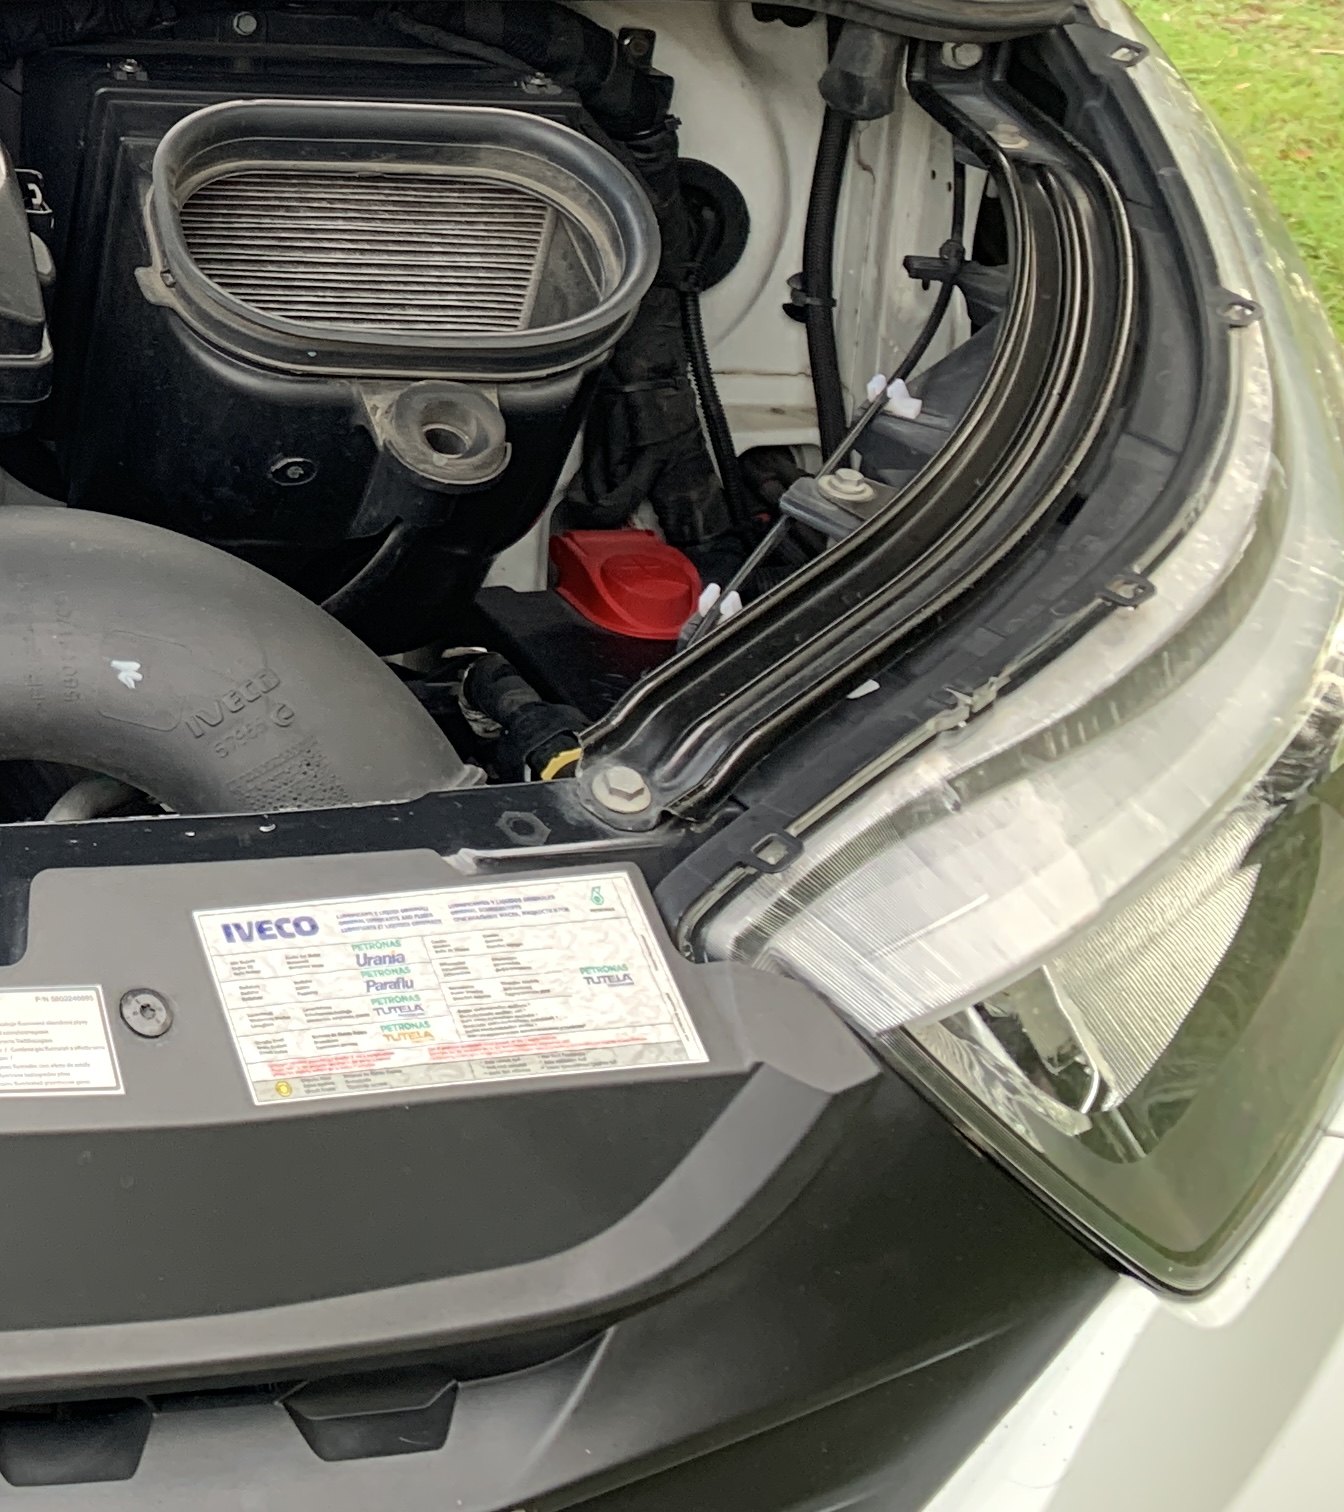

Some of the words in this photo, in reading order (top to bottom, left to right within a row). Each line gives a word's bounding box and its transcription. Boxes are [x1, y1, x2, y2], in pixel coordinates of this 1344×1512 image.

[185, 668, 281, 739] IVECO
[220, 915, 320, 944] IVECO
[351, 940, 402, 951] PETRONAS
[355, 950, 406, 967] Urania
[360, 966, 411, 978] PETRONAS
[579, 964, 629, 975] PETRONAS
[366, 977, 414, 993] Paraflu
[583, 974, 633, 986] TUTELA
[370, 994, 421, 1005] PETRONAS
[373, 1004, 424, 1016] TUTELA
[380, 1021, 431, 1033] PETRONAS
[383, 1031, 434, 1042] TUTELA
